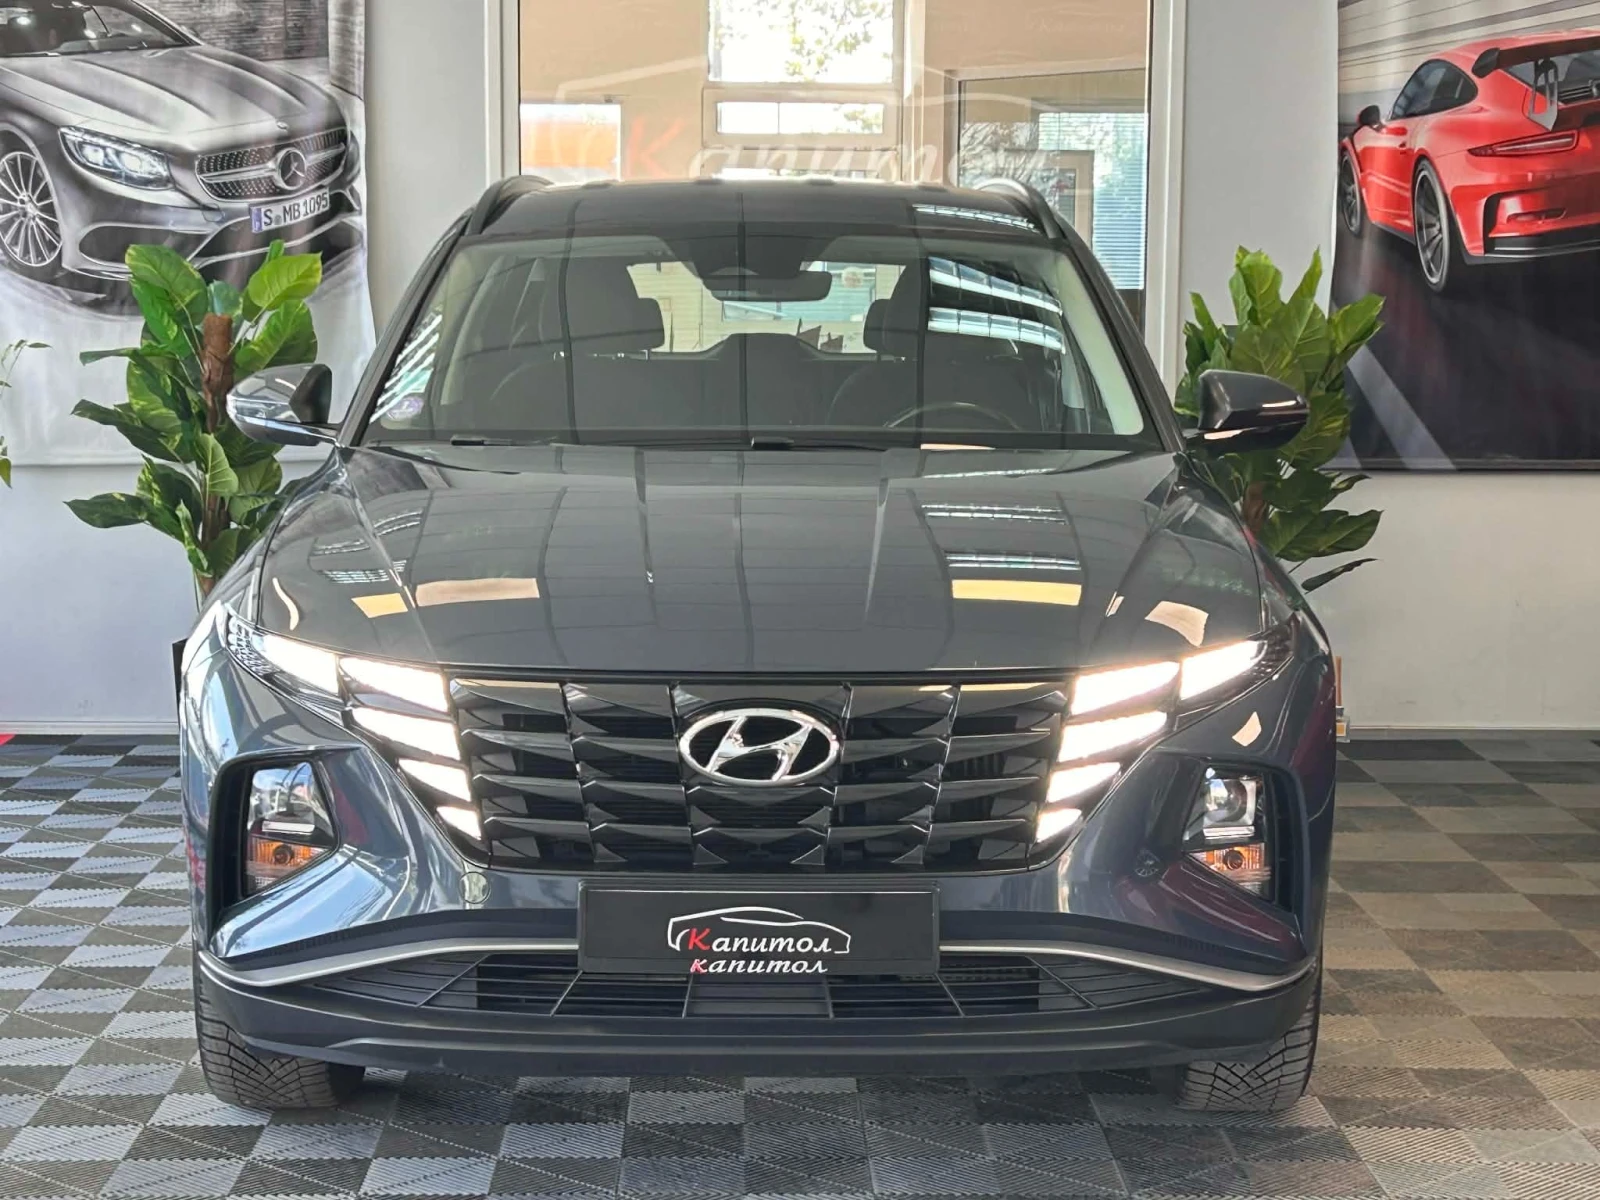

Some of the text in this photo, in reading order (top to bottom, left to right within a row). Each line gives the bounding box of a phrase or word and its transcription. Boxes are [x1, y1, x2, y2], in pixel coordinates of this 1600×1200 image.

[263, 192, 329, 226] S MB 1095
[688, 927, 832, 953] Капитол
